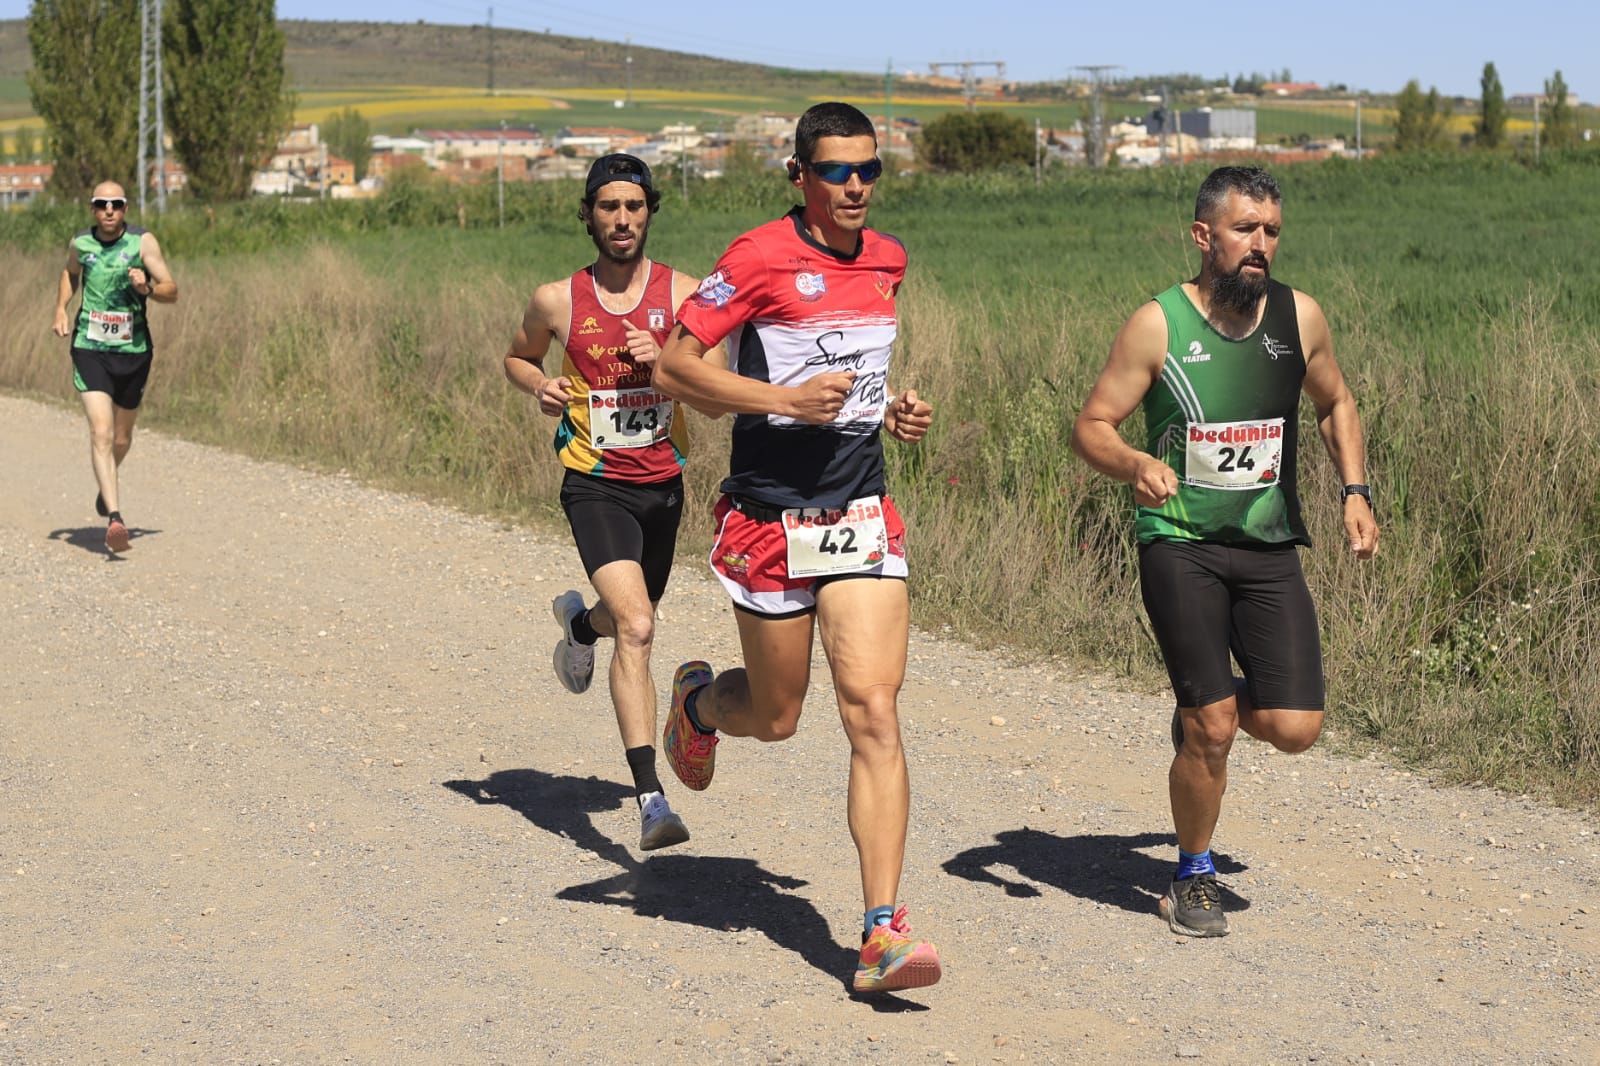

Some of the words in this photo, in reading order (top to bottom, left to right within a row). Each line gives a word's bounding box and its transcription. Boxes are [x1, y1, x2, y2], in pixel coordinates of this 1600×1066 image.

[101, 323, 119, 334] 98
[597, 375, 614, 386] DE
[610, 408, 658, 433] 143
[1189, 424, 1281, 443] bedunia
[1217, 445, 1255, 472] 24
[818, 527, 858, 555] 42
